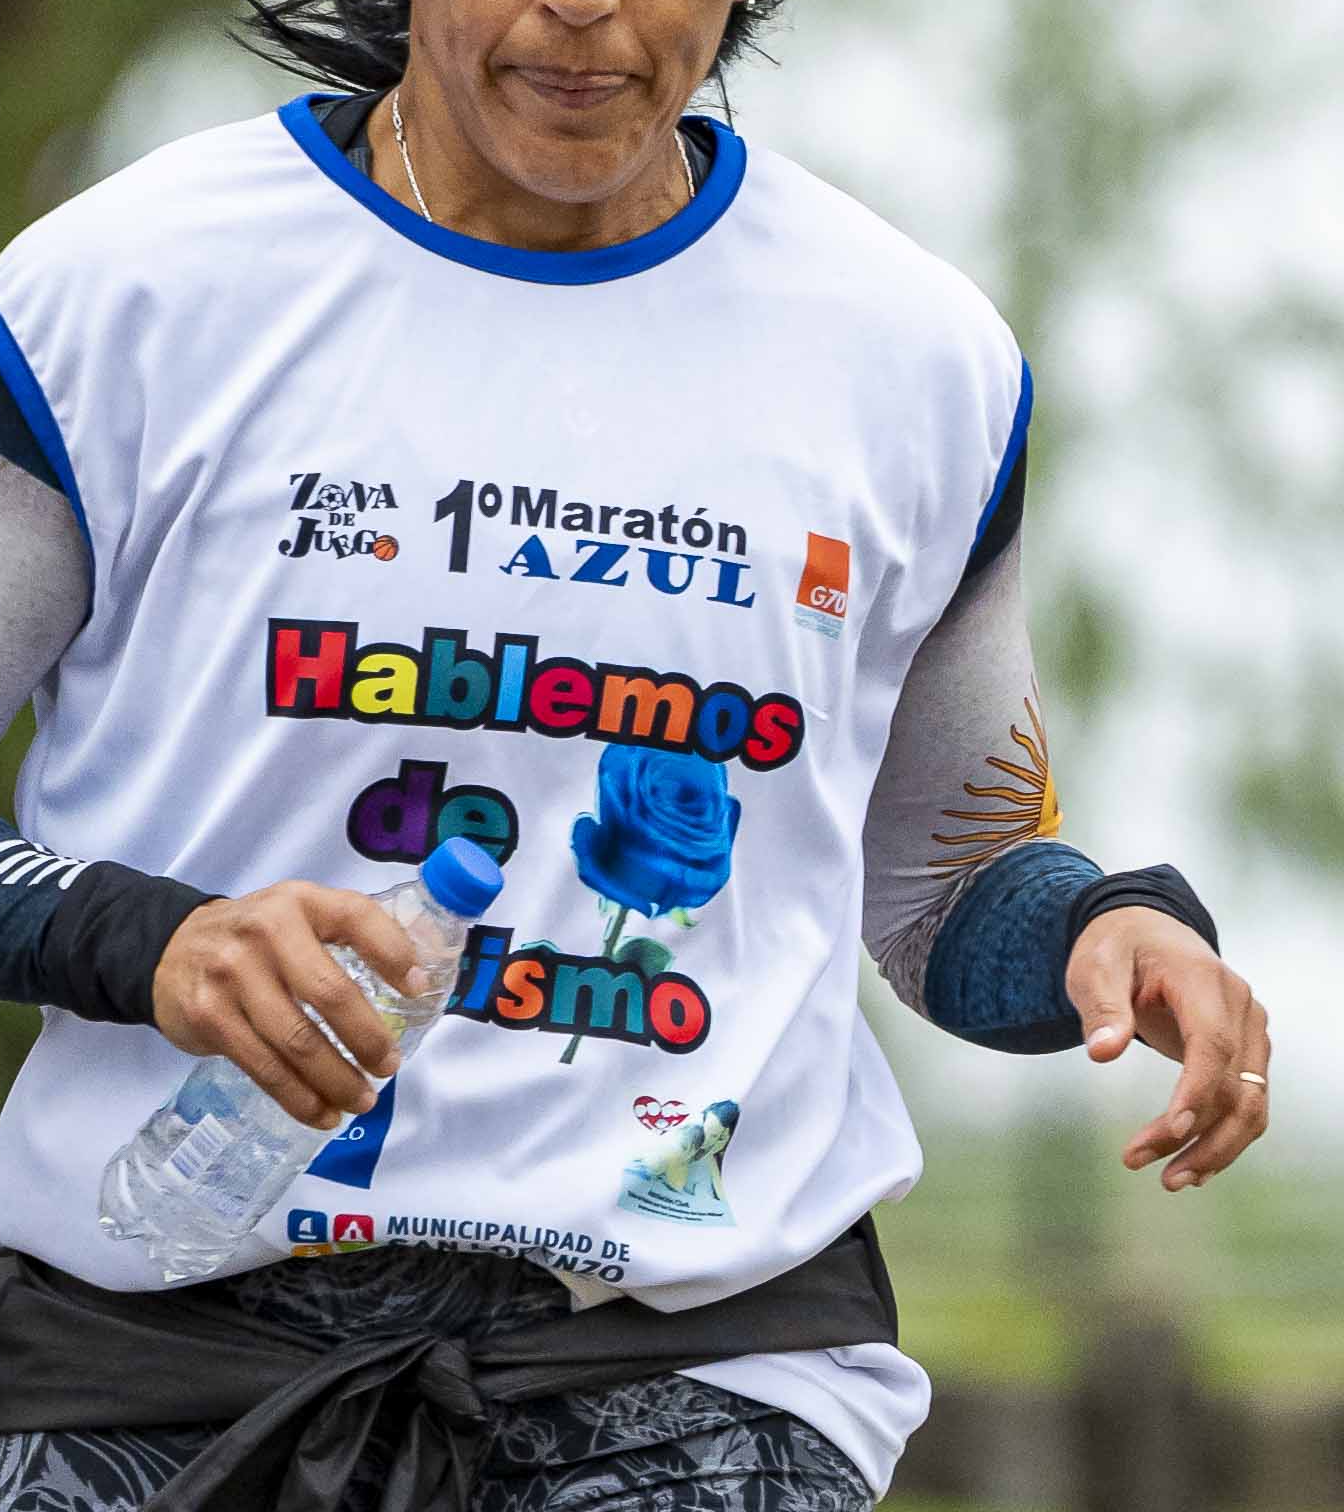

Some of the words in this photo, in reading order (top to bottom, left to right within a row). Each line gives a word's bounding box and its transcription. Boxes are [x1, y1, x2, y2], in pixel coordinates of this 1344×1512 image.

[328, 512, 356, 527] DE
[510, 485, 747, 556] Maratón
[498, 534, 756, 609] AZUL
[266, 617, 805, 772] Hablemos
[346, 759, 519, 867] de
[386, 1215, 593, 1254] MUNICIPALIDAD
[600, 1239, 631, 1263] DE
